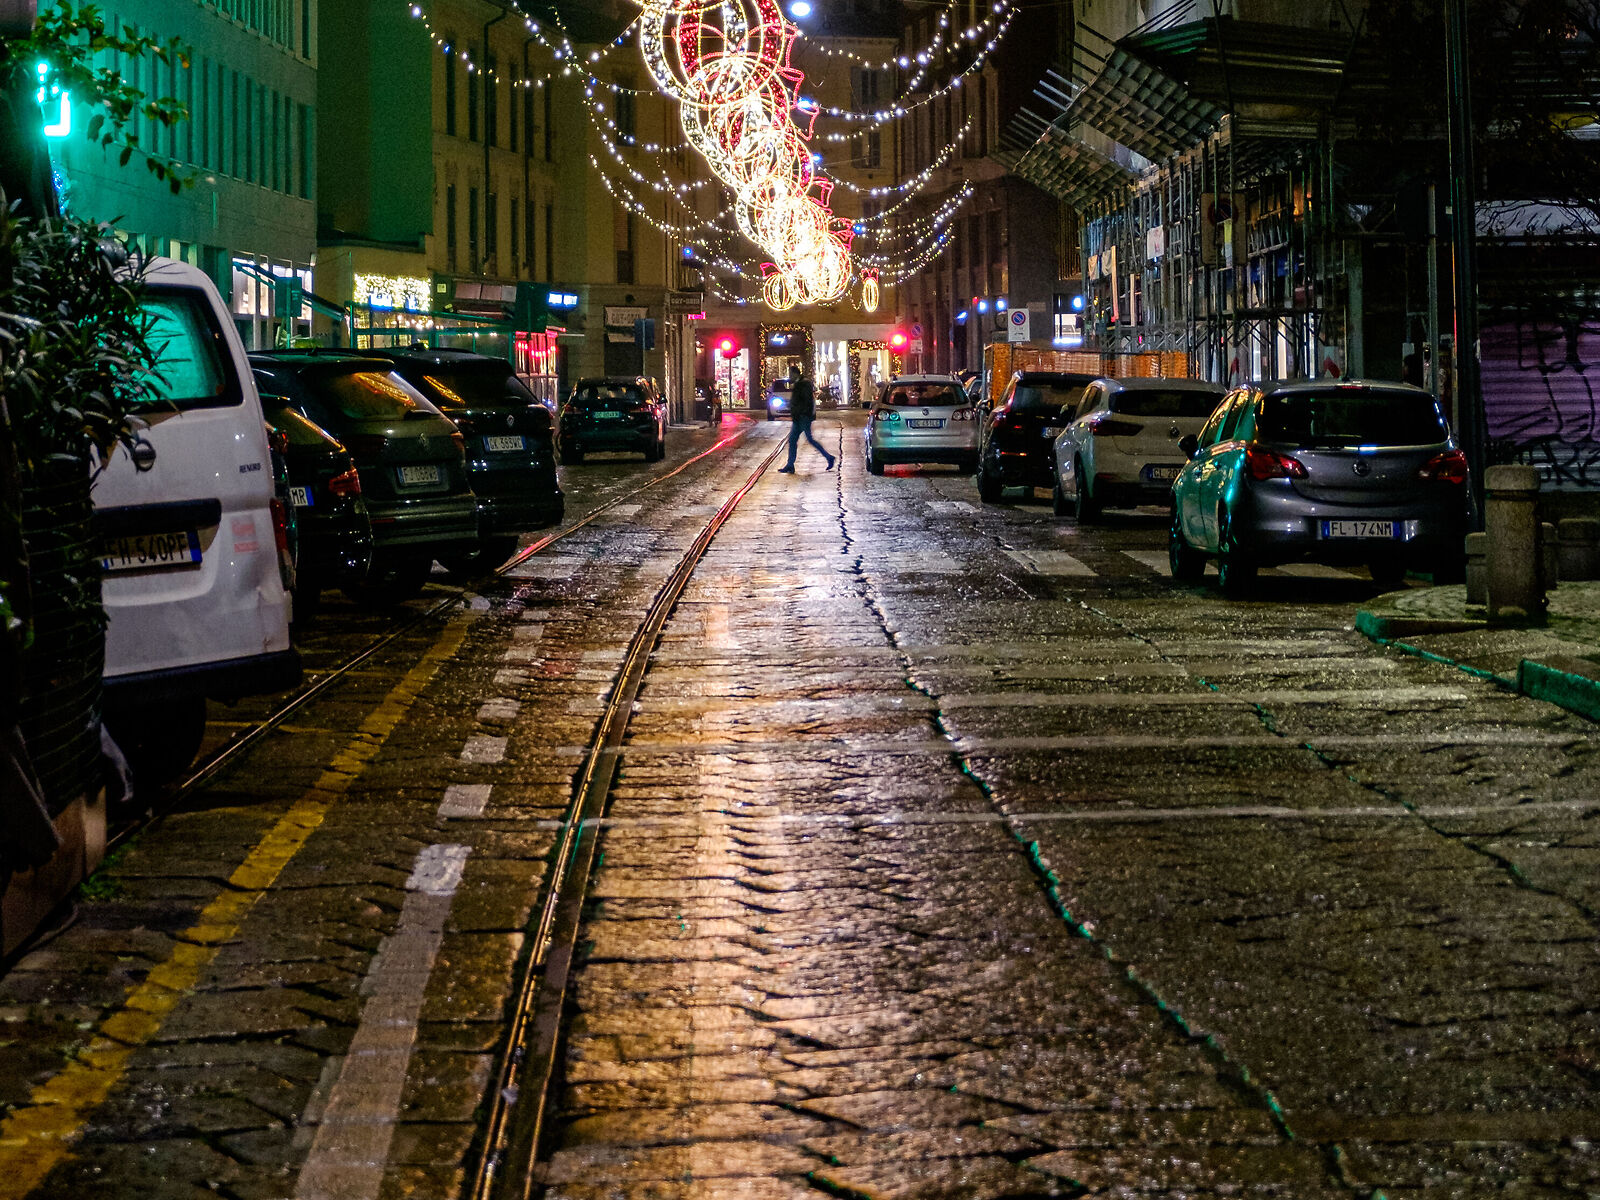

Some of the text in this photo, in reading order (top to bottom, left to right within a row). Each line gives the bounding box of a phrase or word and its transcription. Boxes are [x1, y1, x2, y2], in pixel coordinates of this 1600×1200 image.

[1331, 522, 1392, 535] FL 174NM
[135, 533, 187, 564] 540PF
